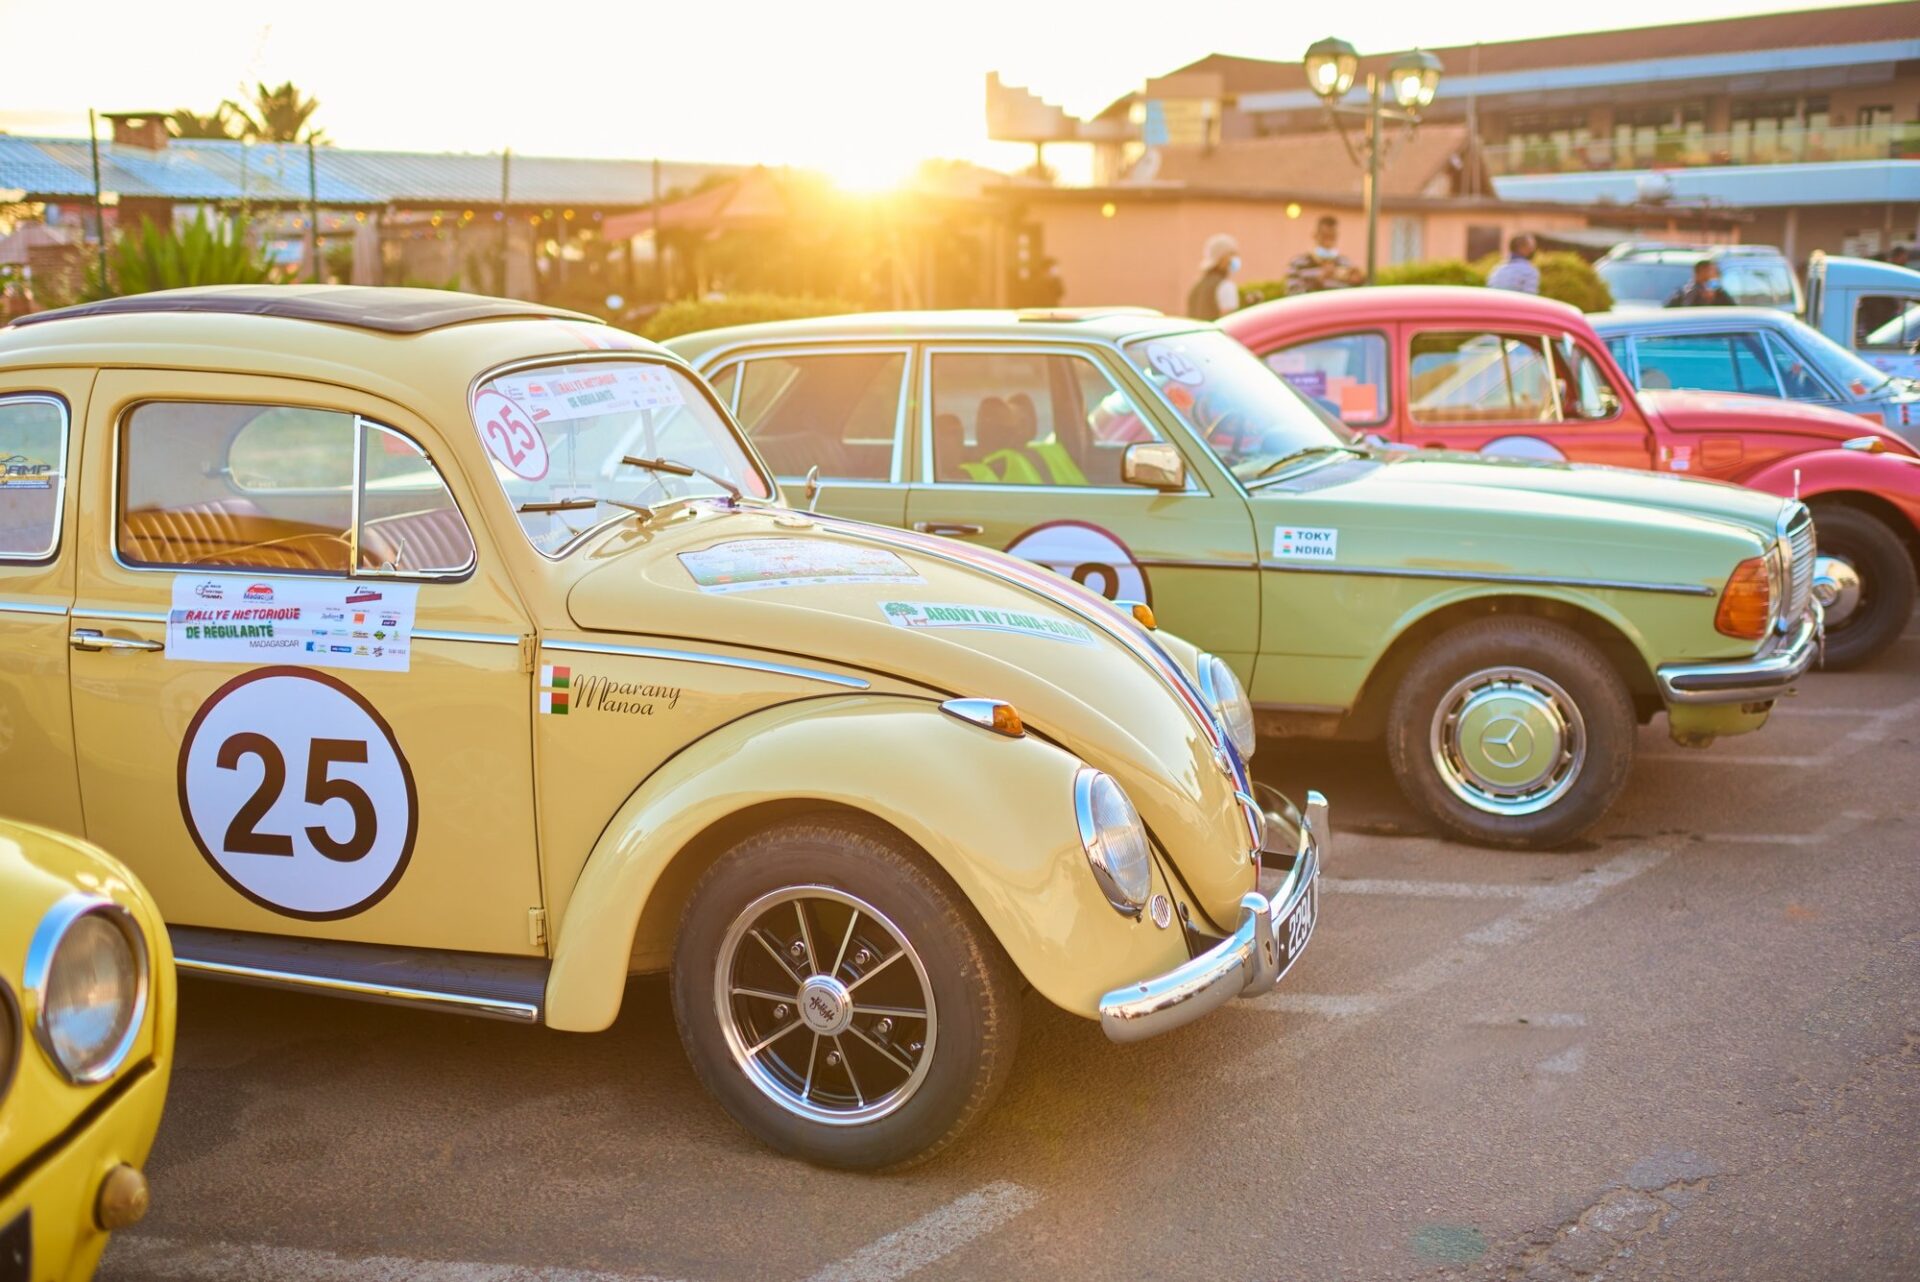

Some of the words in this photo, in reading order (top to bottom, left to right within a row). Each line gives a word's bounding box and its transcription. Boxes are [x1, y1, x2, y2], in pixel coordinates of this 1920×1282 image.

[486, 404, 536, 467] 25
[1297, 531, 1331, 541] TOKY
[1295, 545, 1334, 556] NDRIA
[186, 609, 230, 621] RALLYE
[232, 608, 301, 620] HISTORIQUE
[923, 606, 980, 623] AROVY
[186, 626, 200, 639] DE
[249, 640, 300, 648] MADAGASCAR
[573, 673, 682, 710] Mparany
[215, 732, 378, 862] 25
